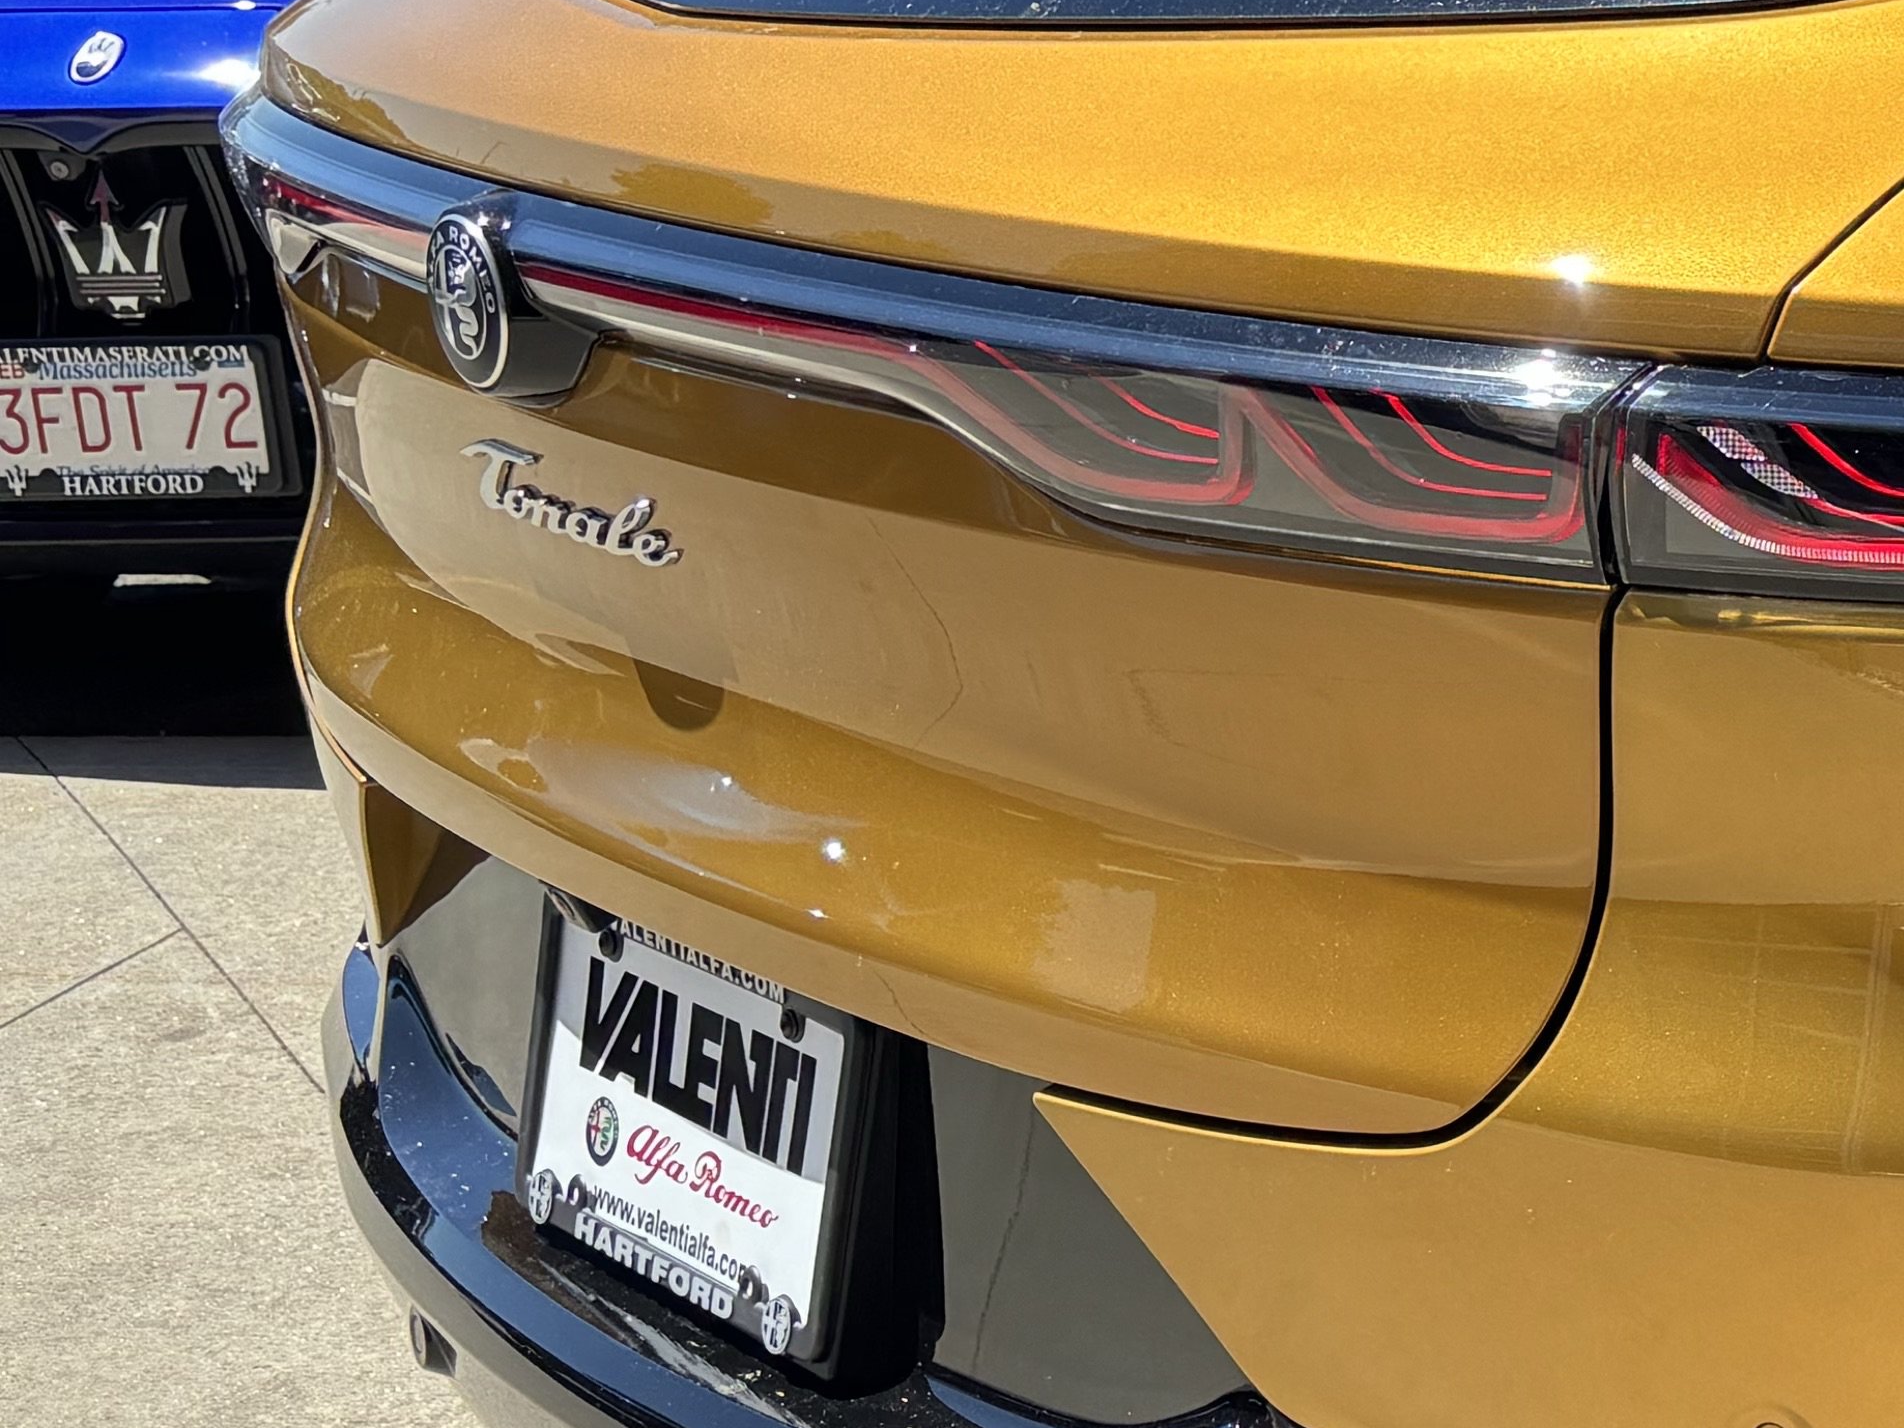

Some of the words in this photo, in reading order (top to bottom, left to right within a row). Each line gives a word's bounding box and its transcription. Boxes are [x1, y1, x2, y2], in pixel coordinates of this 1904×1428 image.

[0, 385, 146, 456] 3FDT
[174, 381, 259, 451] 72
[62, 473, 205, 496] HARTFORD
[459, 437, 685, 568] Tonale
[579, 954, 817, 1178] VALENTI
[626, 1124, 689, 1185] Alfa
[689, 1150, 779, 1229] Romeo
[573, 1211, 734, 1320] HARTFORD
